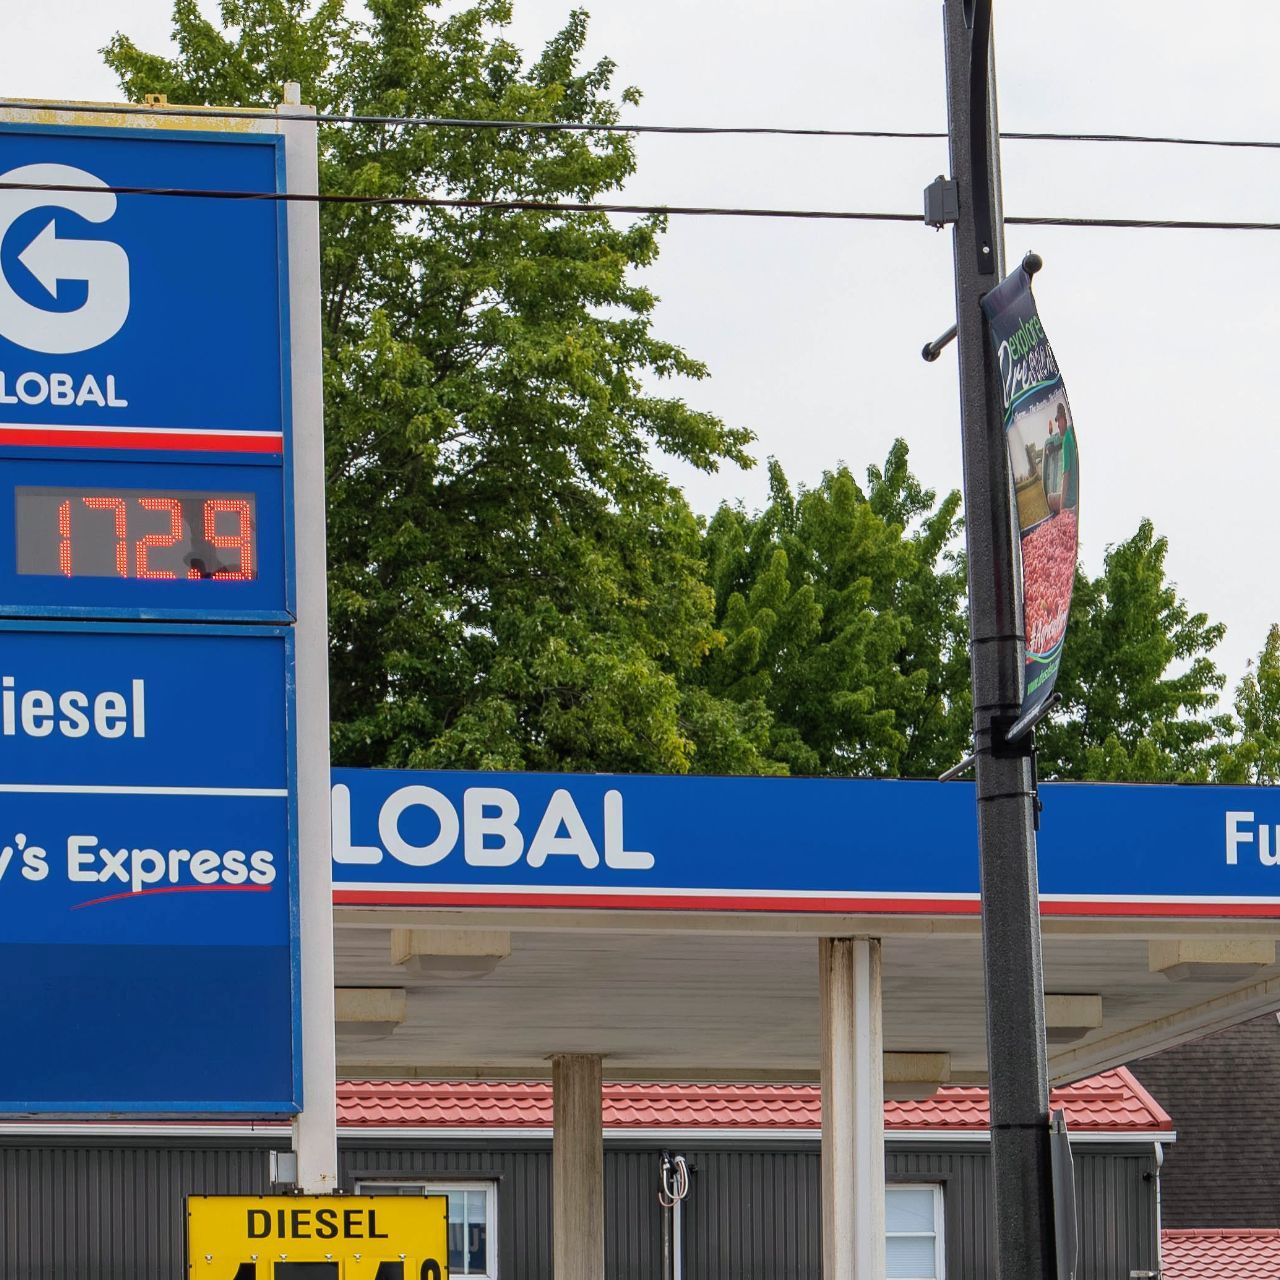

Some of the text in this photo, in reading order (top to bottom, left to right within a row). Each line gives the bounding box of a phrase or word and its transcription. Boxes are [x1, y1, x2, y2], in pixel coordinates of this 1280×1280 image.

[1009, 315, 1044, 360] explore
[58, 497, 253, 581] 172.9
[67, 835, 276, 892] Express
[247, 1209, 388, 1239] DIESEL
